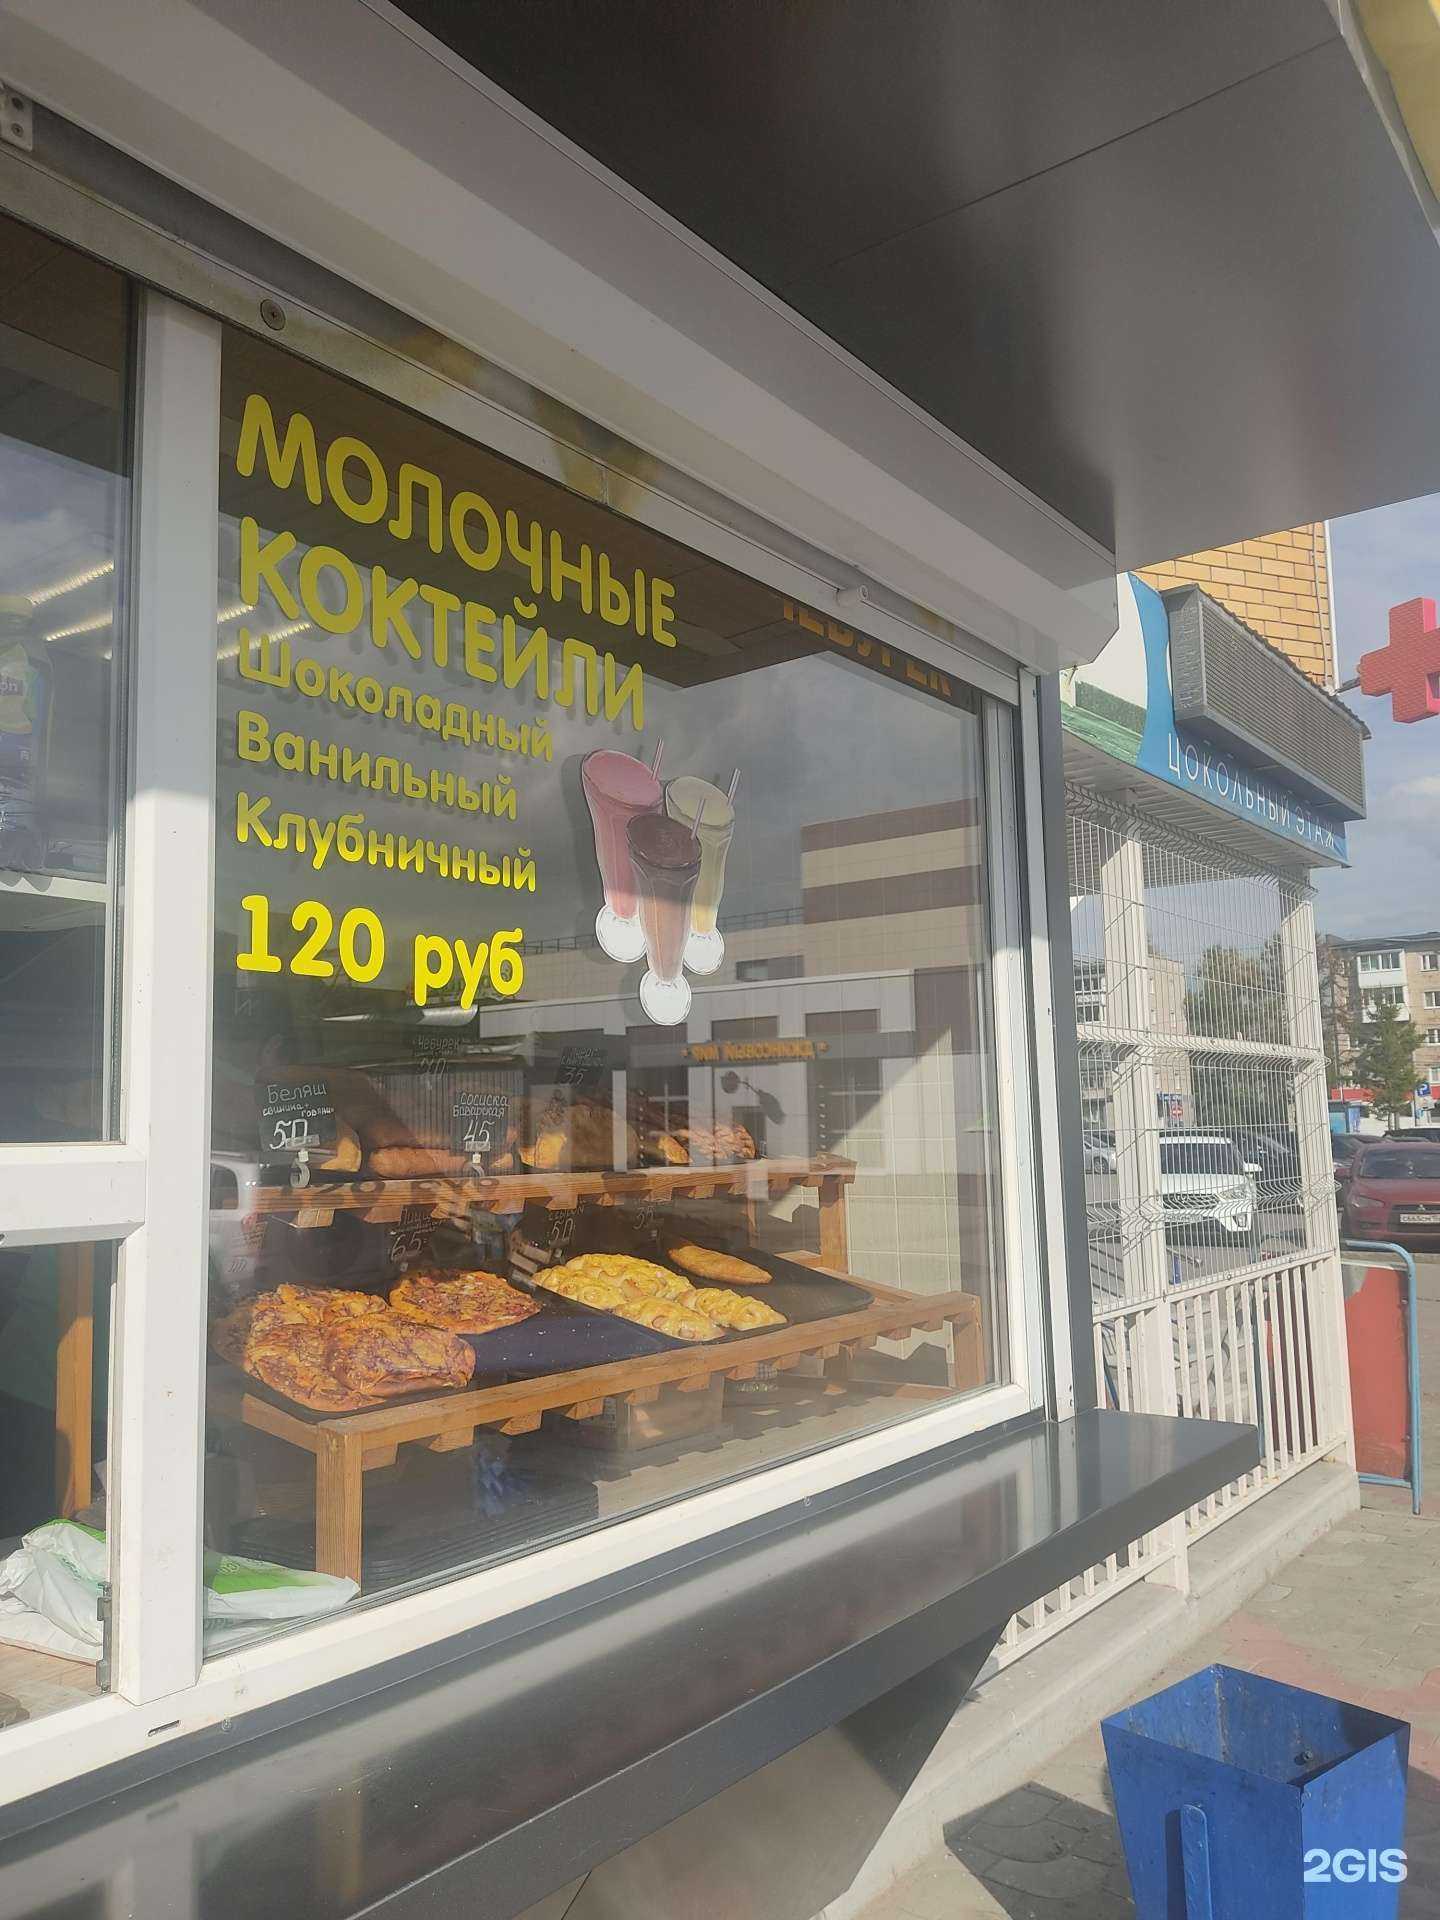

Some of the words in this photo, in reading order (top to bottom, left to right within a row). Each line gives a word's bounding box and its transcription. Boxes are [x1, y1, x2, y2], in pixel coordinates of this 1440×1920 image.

[236, 394, 676, 648] МОЛОЧНЫЕ
[240, 517, 643, 731] КОКТЕЙЛИ
[239, 627, 553, 760] Шоколадный
[238, 710, 517, 820] Ванильный
[1168, 732, 1290, 827] ЦОКОЛЬНЫЙ
[1295, 806, 1335, 849] ЭТАЖ
[236, 791, 537, 892] Клубничный
[236, 895, 386, 983] 120
[414, 928, 525, 1010] руб
[266, 1082, 327, 1103] Беляш
[269, 1118, 308, 1150] 50
[463, 1116, 495, 1147] 45
